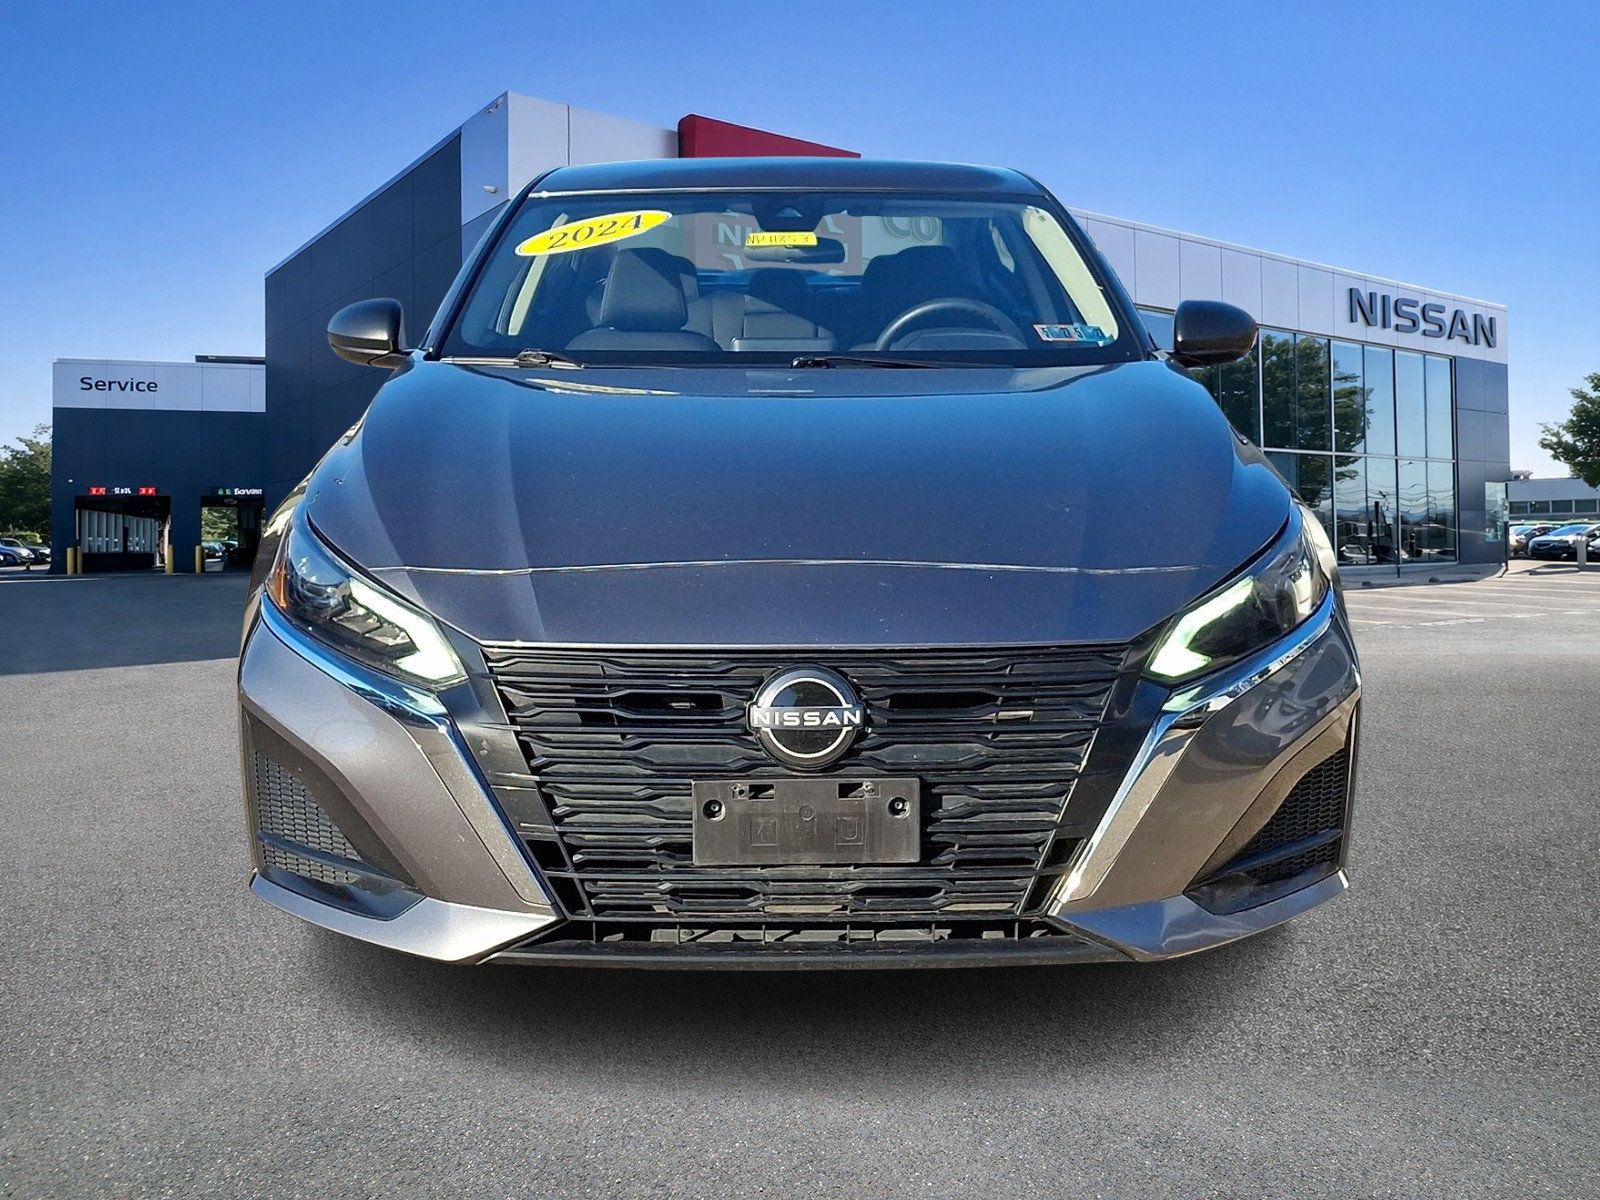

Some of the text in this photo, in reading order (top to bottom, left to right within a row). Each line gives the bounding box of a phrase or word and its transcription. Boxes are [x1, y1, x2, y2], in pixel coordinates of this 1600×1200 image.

[547, 214, 643, 250] 2024
[1348, 287, 1497, 348] NISSAN
[80, 376, 158, 392] Service
[752, 709, 861, 727] NISSAN
